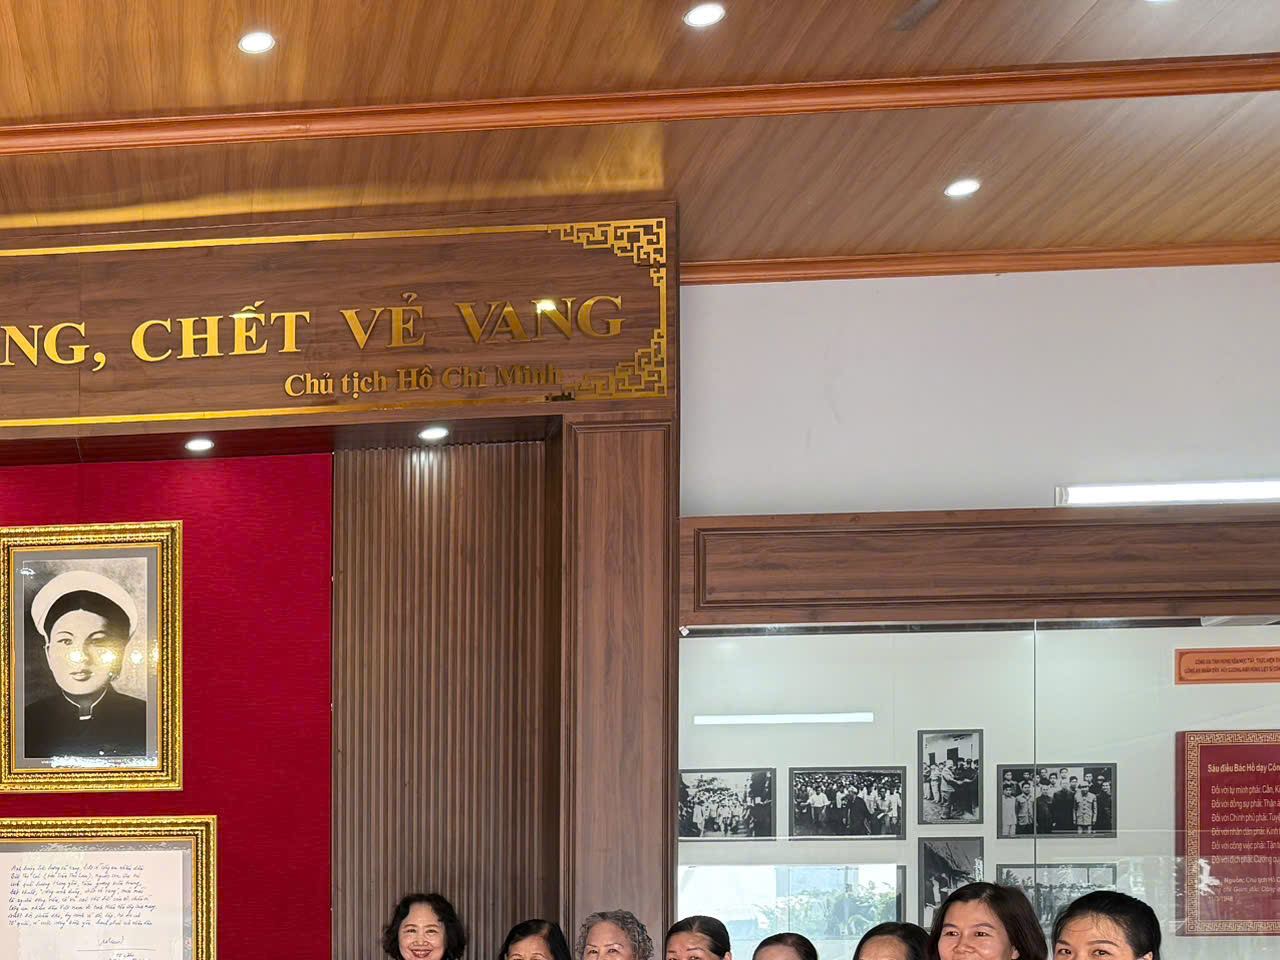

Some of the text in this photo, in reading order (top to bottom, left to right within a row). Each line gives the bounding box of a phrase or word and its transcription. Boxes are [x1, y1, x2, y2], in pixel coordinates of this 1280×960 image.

[130, 300, 311, 363] CHẾT
[339, 292, 426, 350] VẺ
[454, 295, 626, 345] VANG
[284, 363, 562, 399] Chủ tịch Hồ Chí Minh
